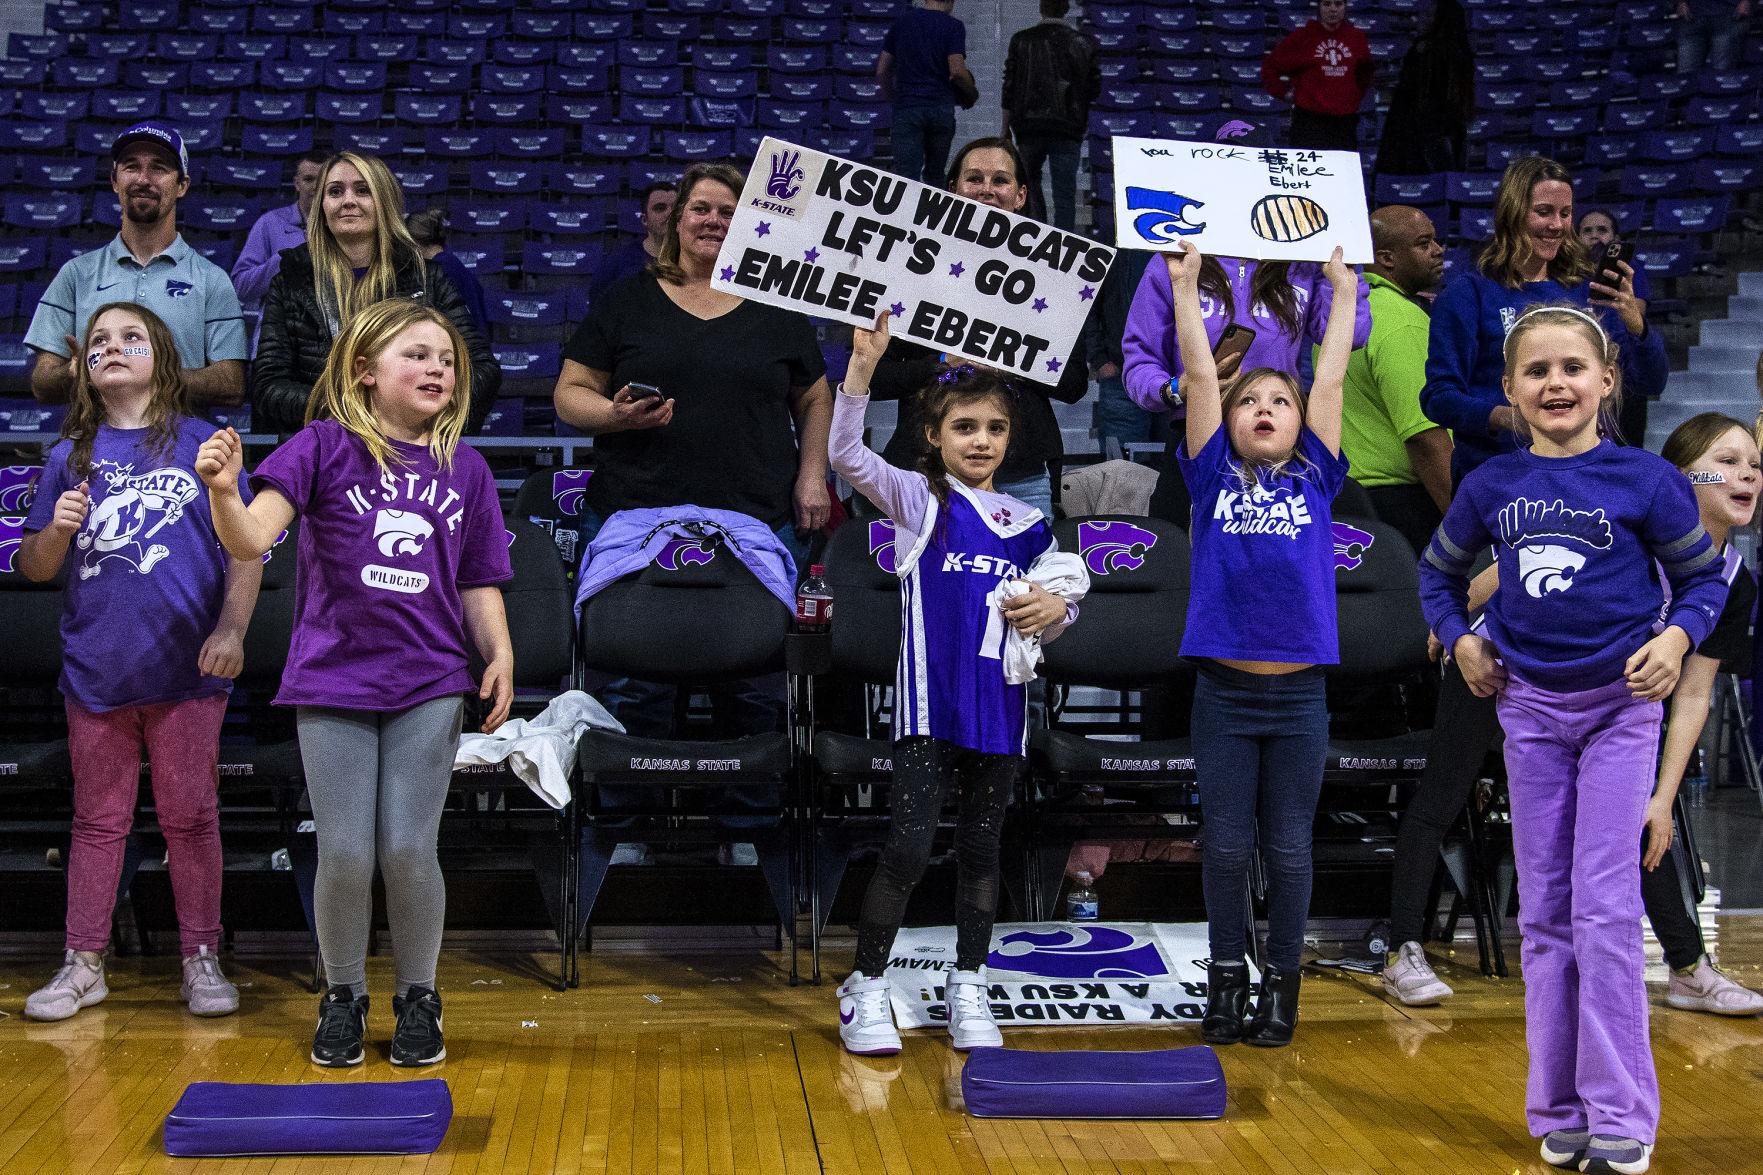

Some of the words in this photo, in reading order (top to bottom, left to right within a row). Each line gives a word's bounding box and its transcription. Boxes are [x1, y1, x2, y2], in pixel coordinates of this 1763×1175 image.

[135, 126, 172, 142] Columbia
[1191, 147, 1251, 162] rock
[1296, 150, 1323, 163] 24
[1268, 162, 1334, 177] Emilee
[1270, 175, 1312, 189] Ebert
[750, 197, 796, 217] K-STATE
[815, 158, 908, 216] KSU
[912, 187, 1114, 284] WILDCATS
[821, 210, 942, 275] LET'S
[974, 259, 1036, 305] GO
[733, 247, 888, 321] EMILEE
[907, 300, 1050, 373] EBERT
[128, 474, 190, 496] STATE
[1689, 471, 1723, 483] Wildcats
[114, 498, 143, 538] K
[369, 570, 422, 588] WILDCATS
[216, 763, 254, 776] TATE
[630, 757, 690, 771] KANSAS
[696, 758, 741, 771] STATE
[1100, 758, 1160, 771] KANSAS
[1166, 758, 1196, 770] STA
[1339, 757, 1397, 770] KANSAS
[1402, 758, 1427, 770] STA
[1020, 983, 1110, 1001] KSU
[926, 1003, 1126, 1020] RAIDES
